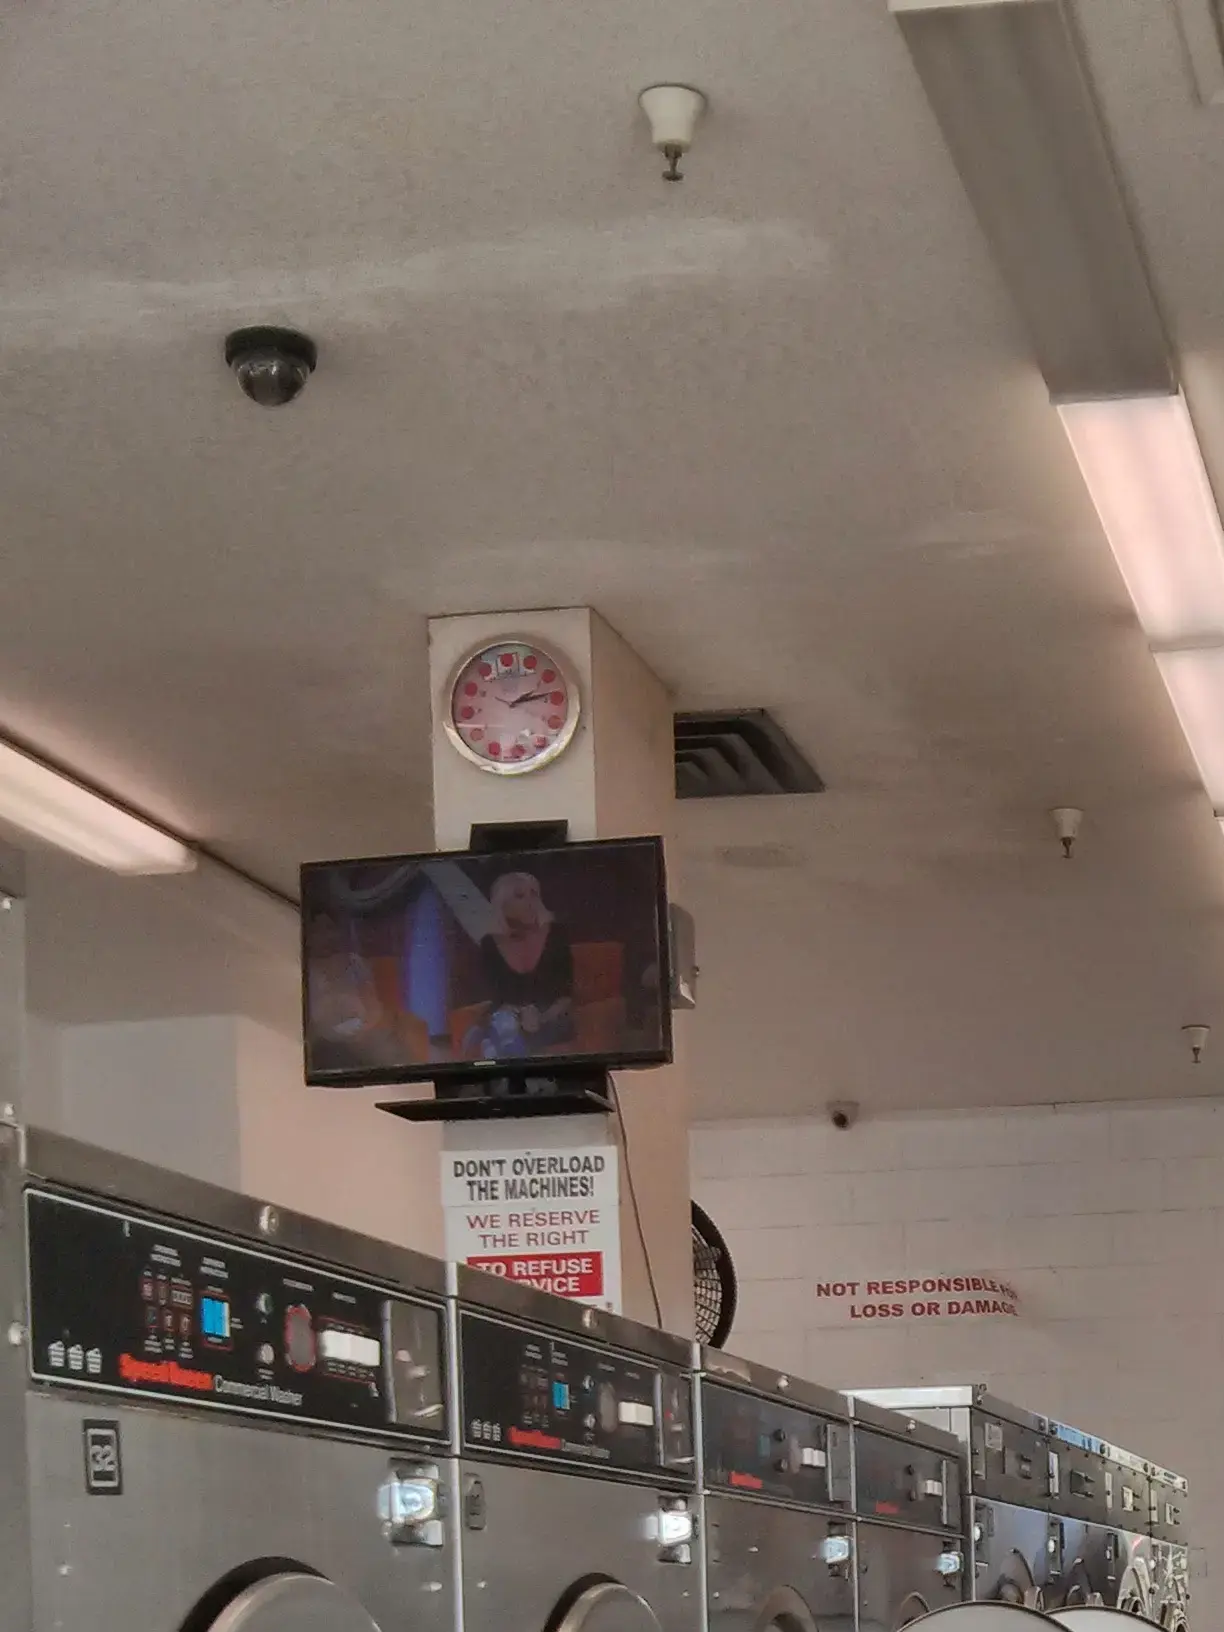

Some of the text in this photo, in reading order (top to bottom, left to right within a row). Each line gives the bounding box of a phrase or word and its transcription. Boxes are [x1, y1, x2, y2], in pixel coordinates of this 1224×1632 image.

[453, 1155, 605, 1178] DON'T OVERLOAD
[466, 1176, 594, 1201] THE MACHINES!
[466, 1209, 601, 1229] WE RESERVE
[478, 1230, 589, 1249] THE RIGHT
[513, 1258, 593, 1276] REFUSE
[816, 1282, 860, 1297] NOT
[867, 1277, 999, 1296] RESPONSIBLE
[850, 1303, 904, 1319] LOSS
[911, 1302, 940, 1317] OR
